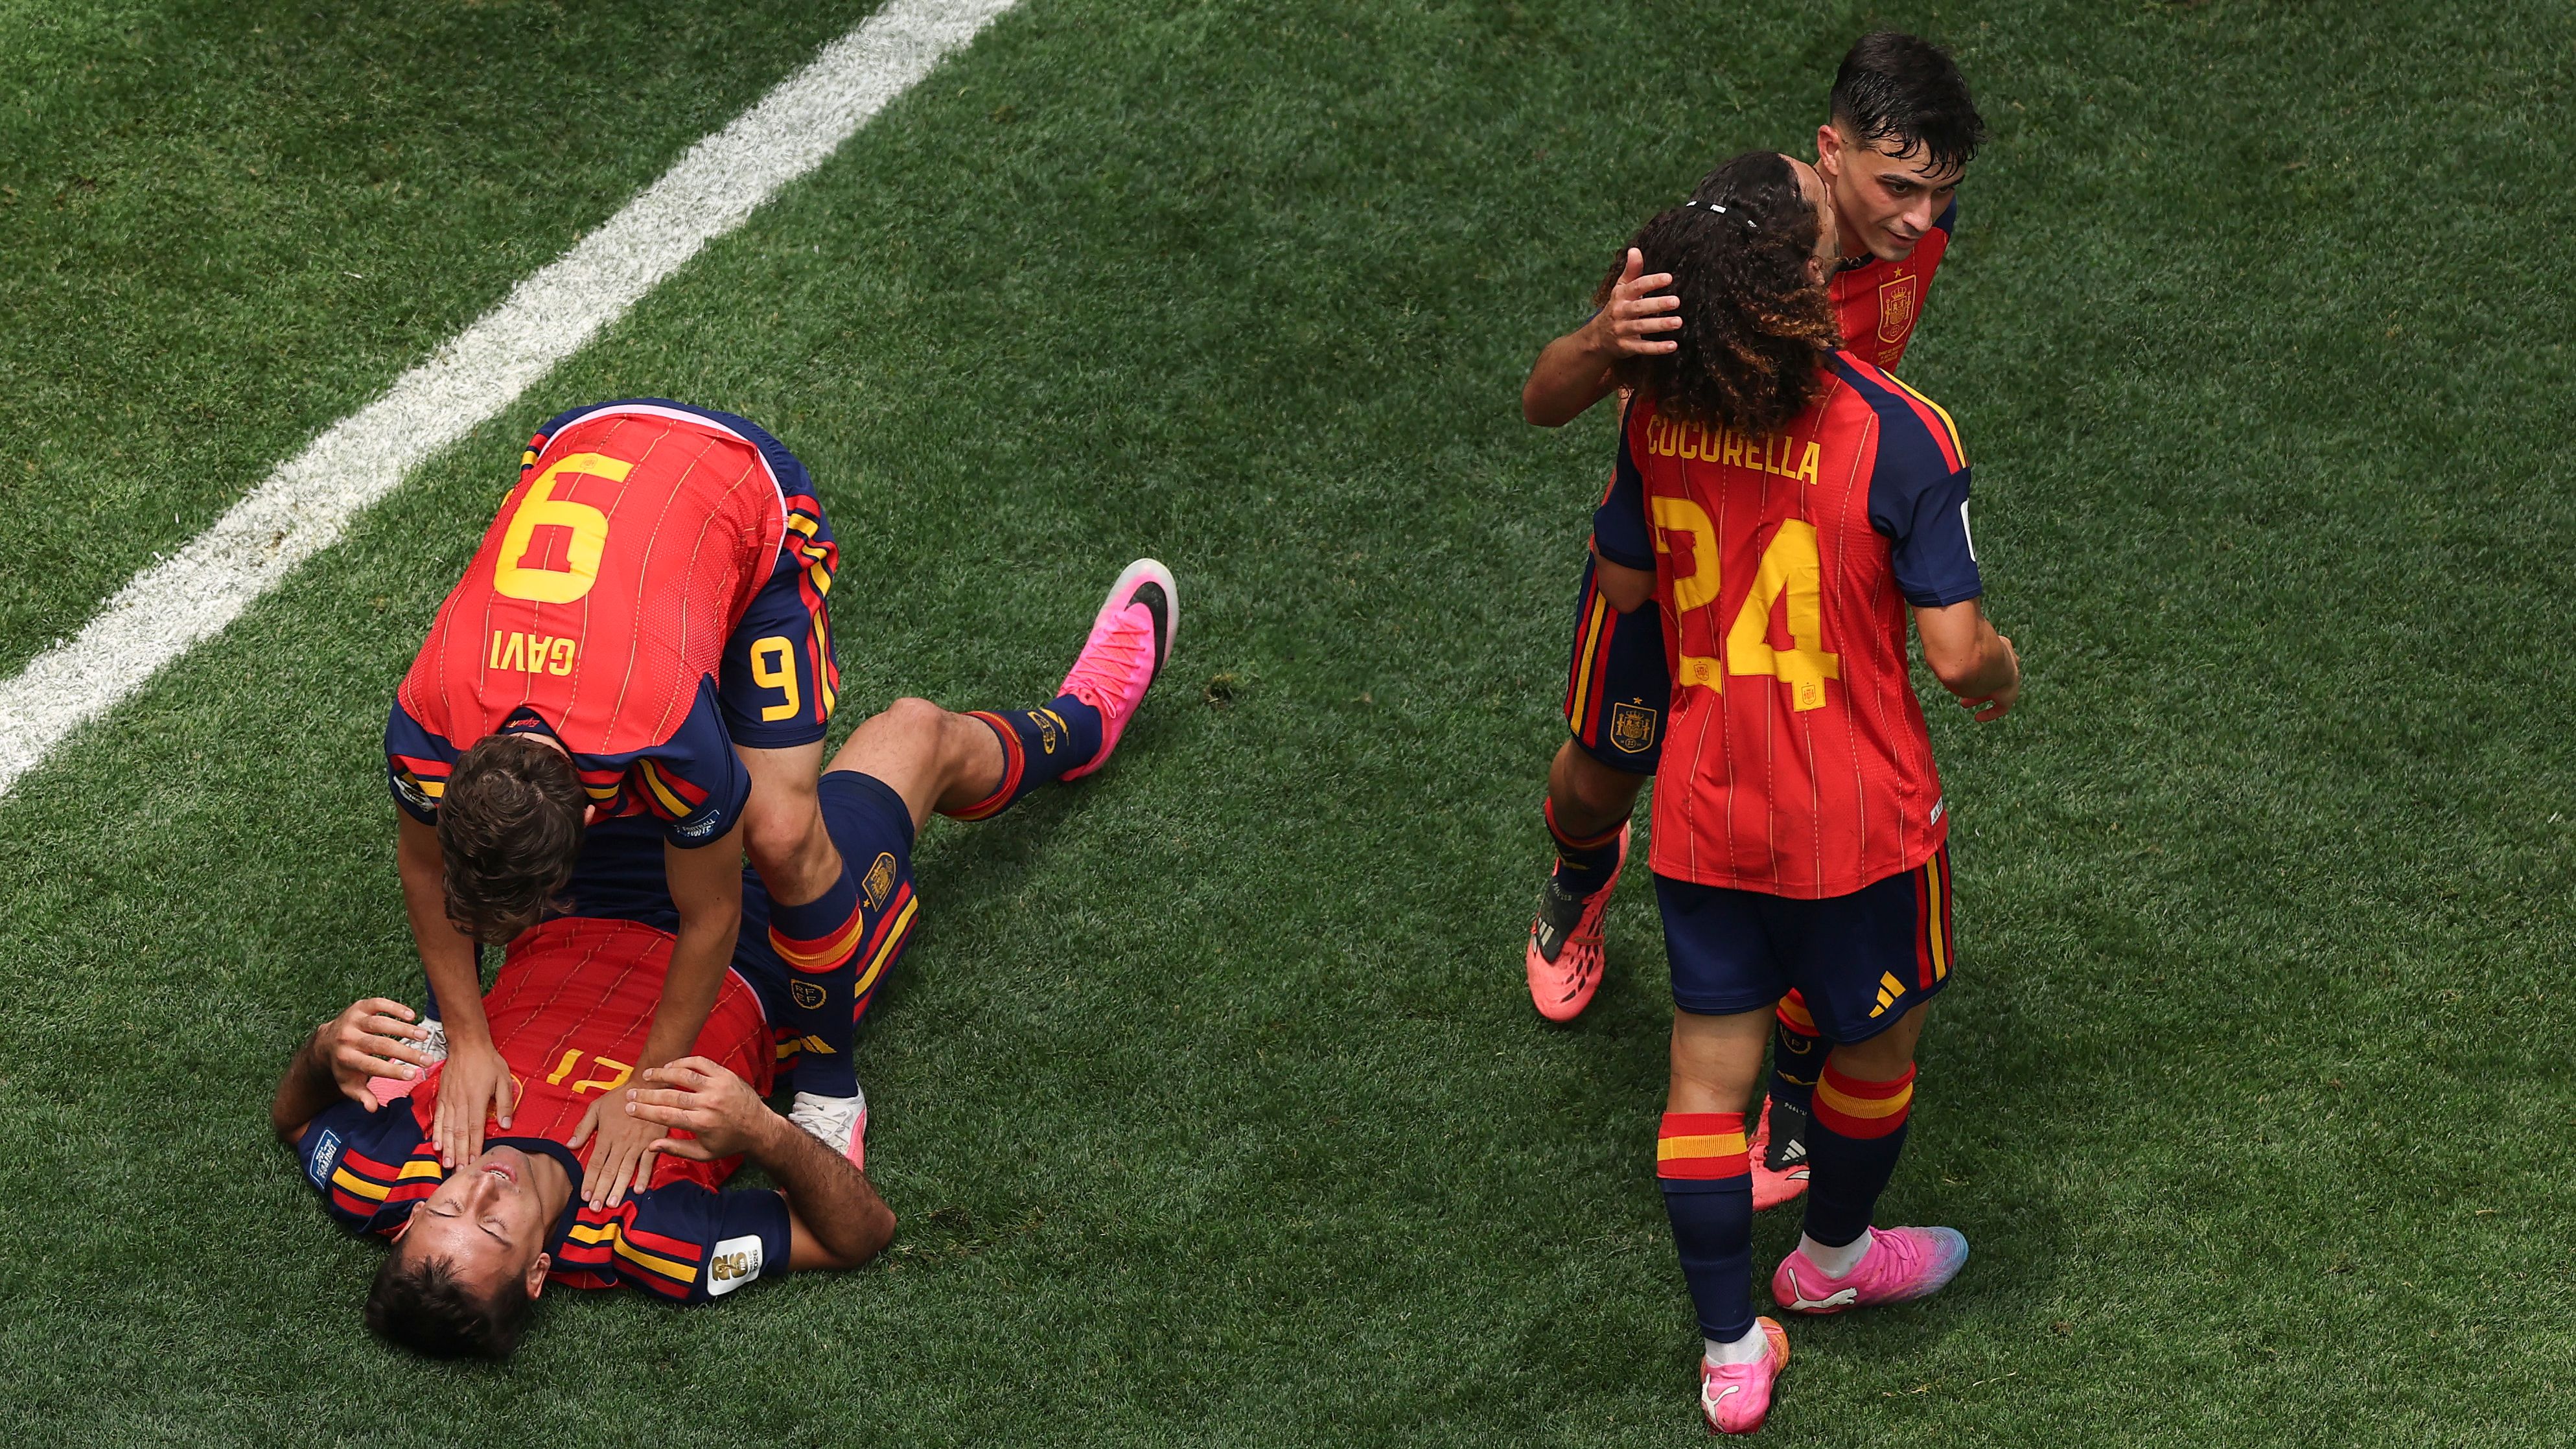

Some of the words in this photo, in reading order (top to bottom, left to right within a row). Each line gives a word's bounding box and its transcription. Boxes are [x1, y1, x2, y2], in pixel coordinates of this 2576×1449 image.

[1646, 414, 1820, 485] CUCURELLA
[493, 452, 635, 605] 9
[1651, 495, 1839, 712] 24
[489, 630, 576, 677] GAVI
[750, 635, 800, 722] 9
